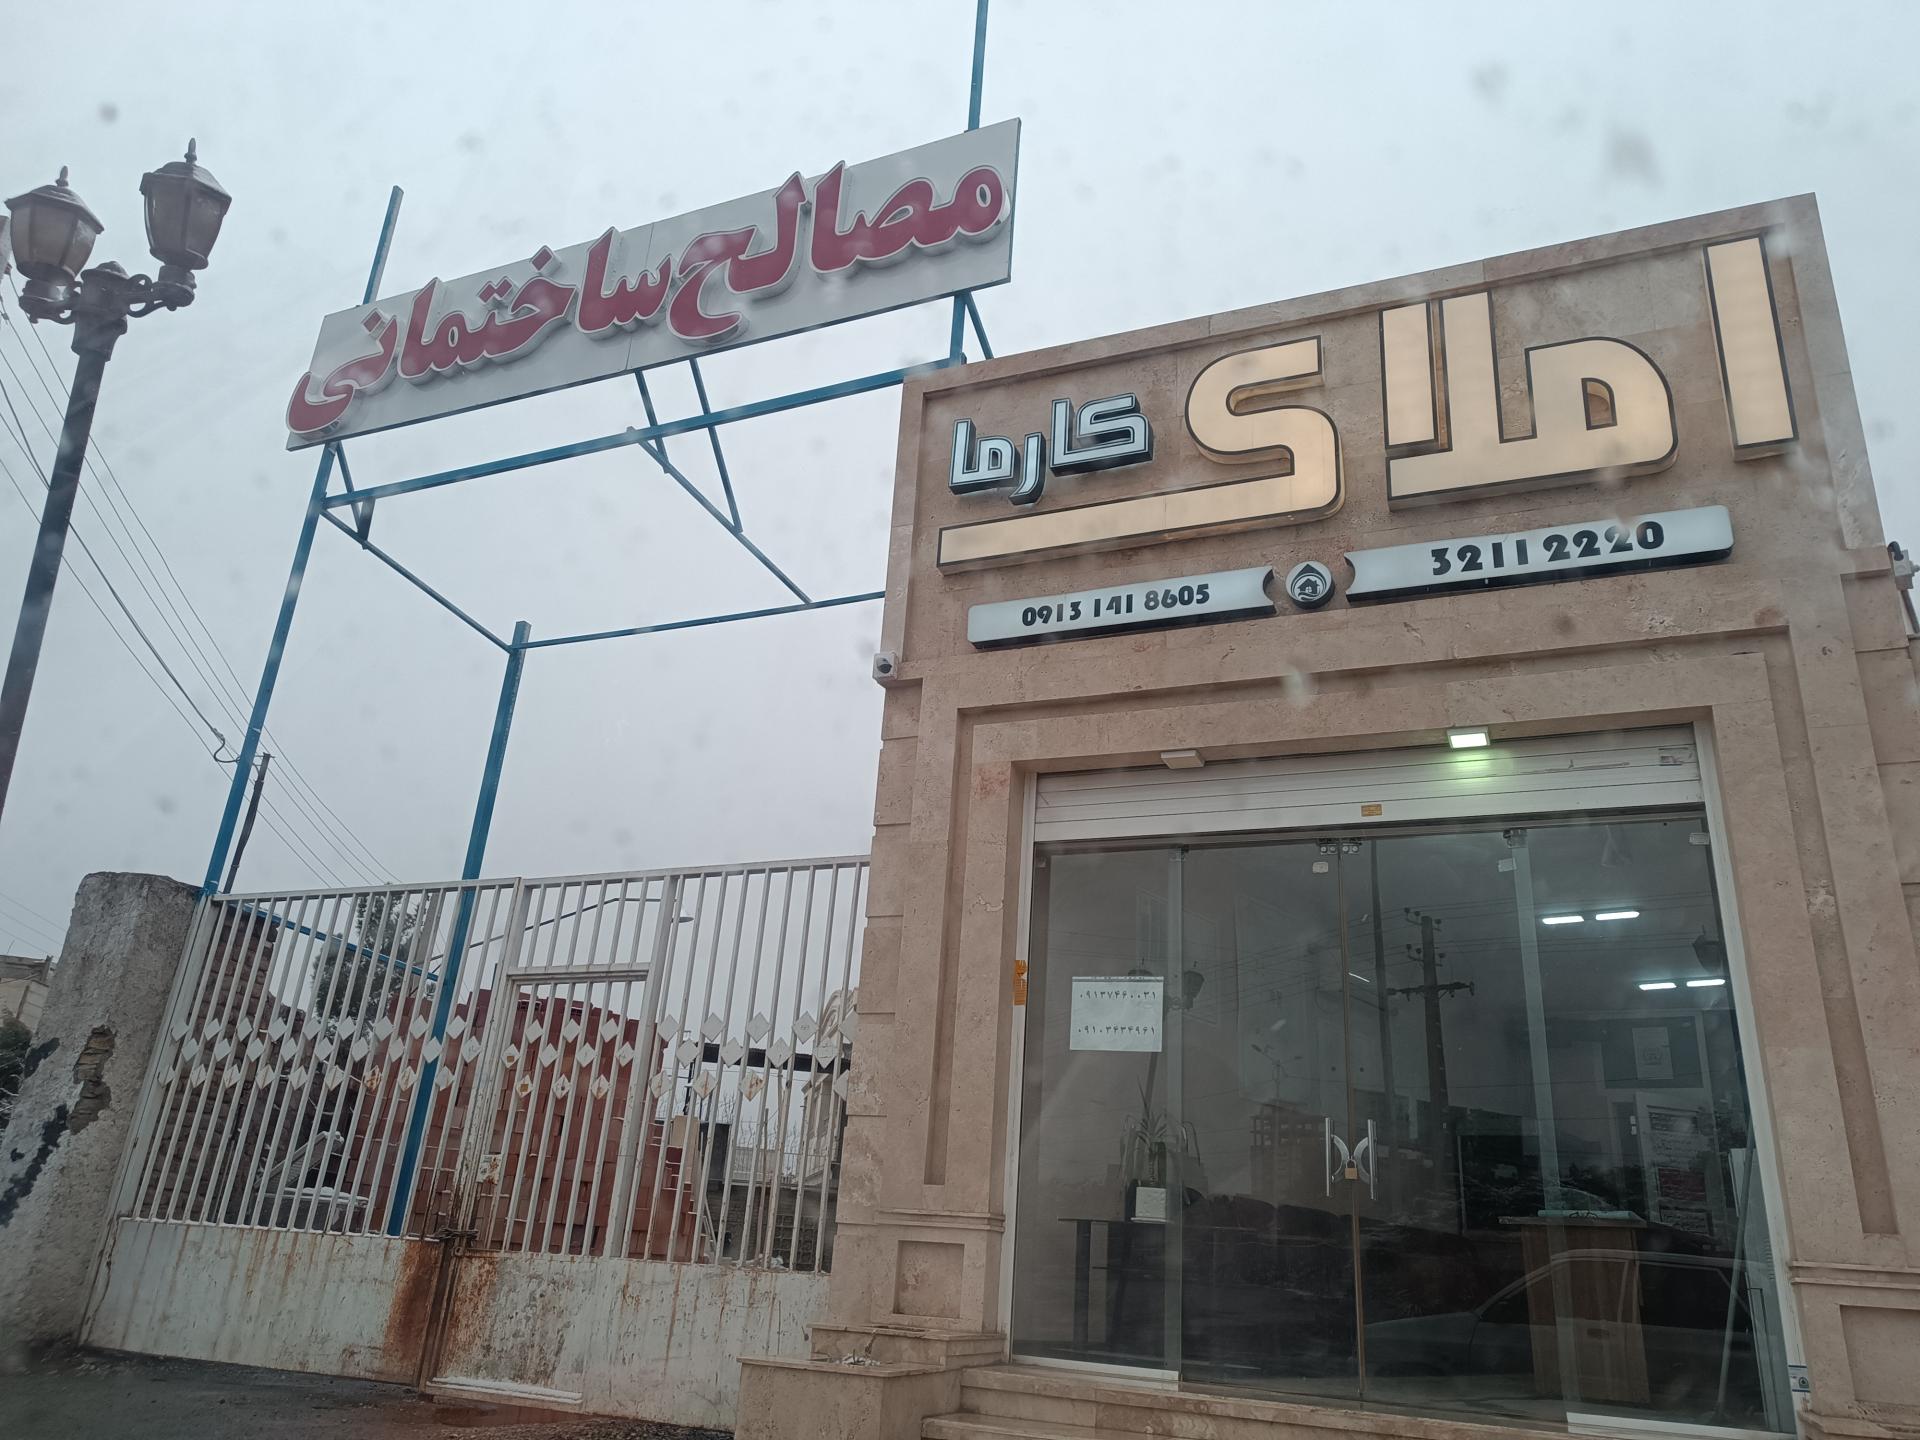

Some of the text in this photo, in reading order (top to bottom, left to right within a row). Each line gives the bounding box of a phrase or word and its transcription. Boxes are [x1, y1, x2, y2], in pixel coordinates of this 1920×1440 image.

[286, 160, 1009, 436] مصالح ساختمانی
[937, 235, 1797, 573] املاک کارما
[1021, 583, 1211, 627] 0913 141 8605
